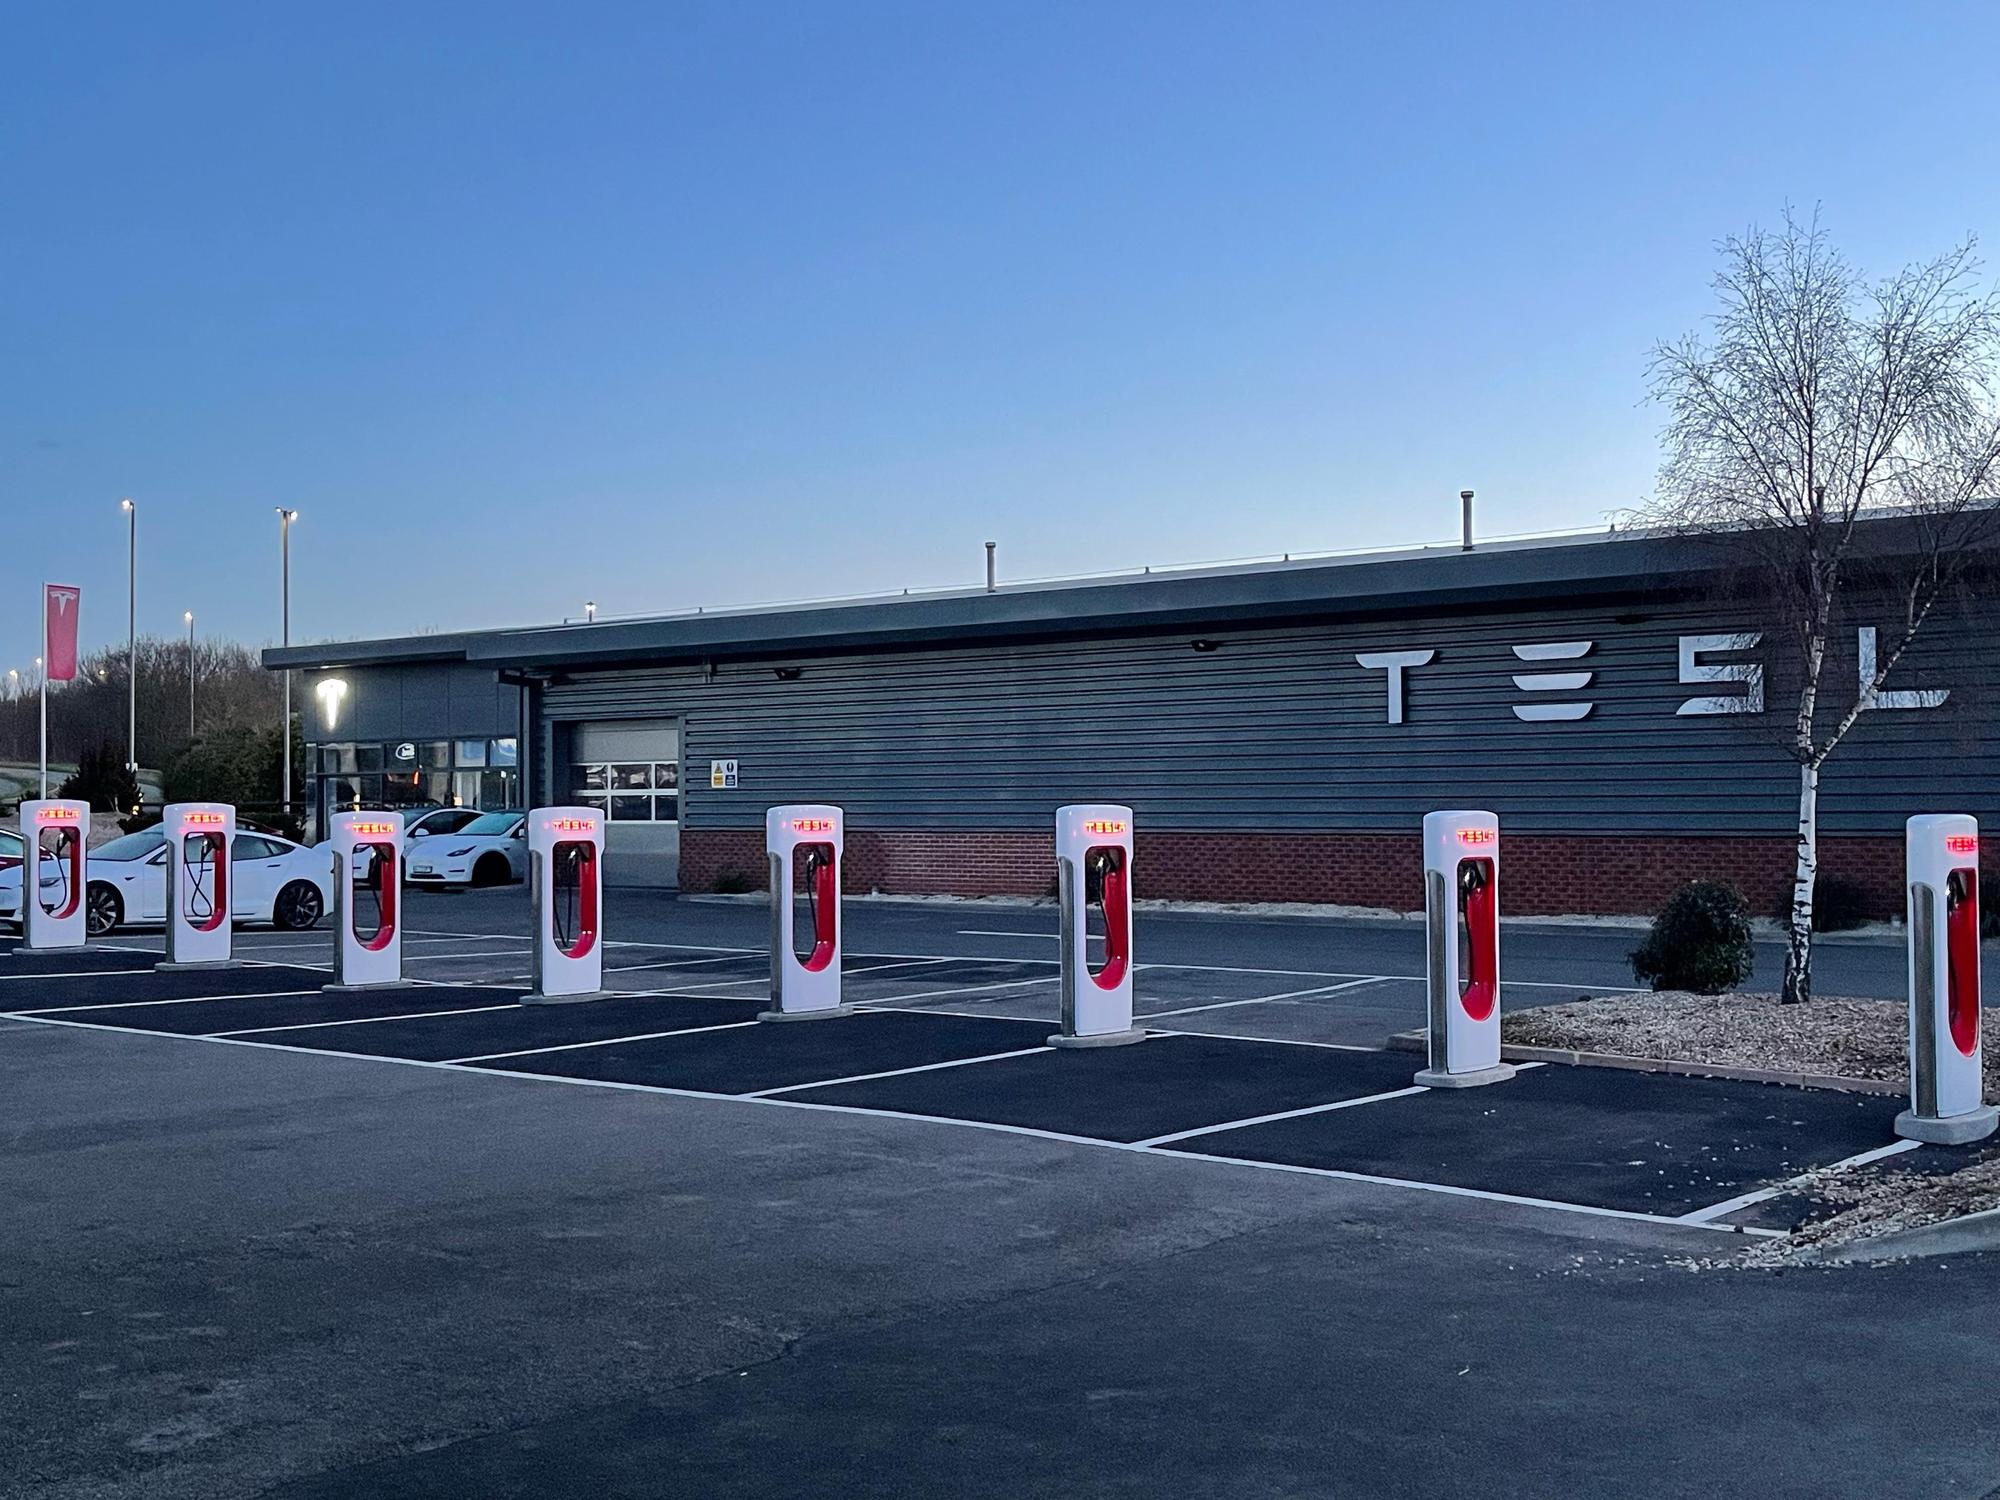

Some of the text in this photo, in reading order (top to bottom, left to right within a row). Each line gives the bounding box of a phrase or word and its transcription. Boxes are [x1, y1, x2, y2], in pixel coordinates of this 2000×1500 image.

[38, 810, 81, 819] TESLA
[184, 814, 225, 823] TESLA
[352, 824, 394, 833] TESLA
[552, 819, 596, 830] TESLA
[793, 820, 835, 831] TESLA
[1085, 822, 1126, 832] TESLA
[1457, 831, 1495, 842] TESLA
